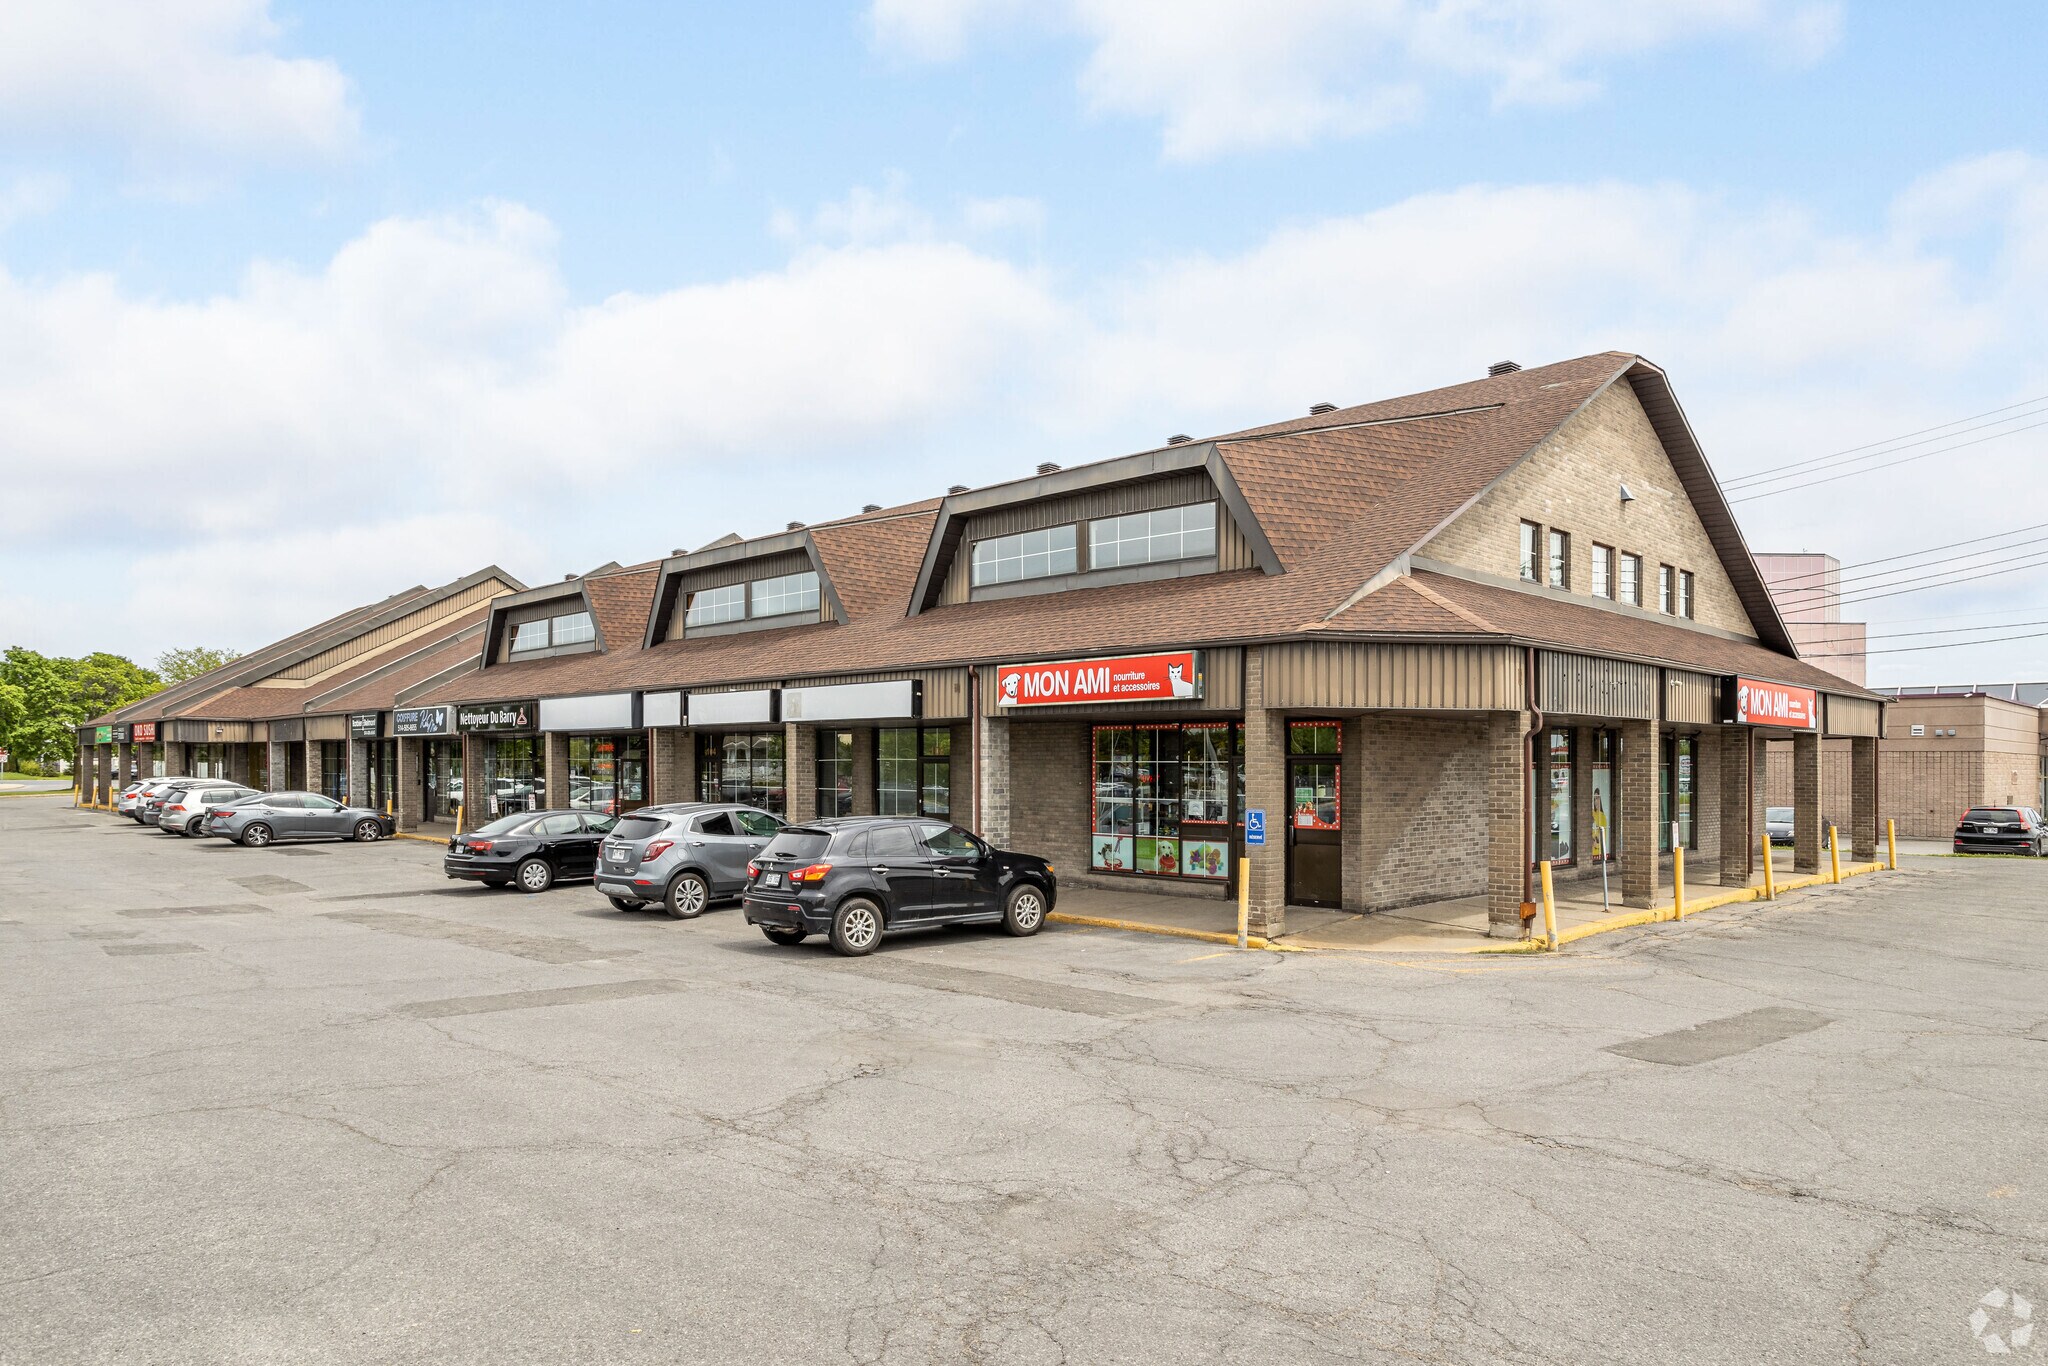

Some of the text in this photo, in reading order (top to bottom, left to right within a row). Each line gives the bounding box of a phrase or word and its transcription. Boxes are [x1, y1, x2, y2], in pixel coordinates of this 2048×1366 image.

[1024, 667, 1110, 697] MON AMI
[1113, 671, 1145, 682] nourriture
[1113, 681, 1161, 692] et accessoires
[1750, 688, 1788, 718] MON AMI
[397, 712, 418, 722] COIFFURE
[460, 710, 517, 728] Nettoyeur Du Barry
